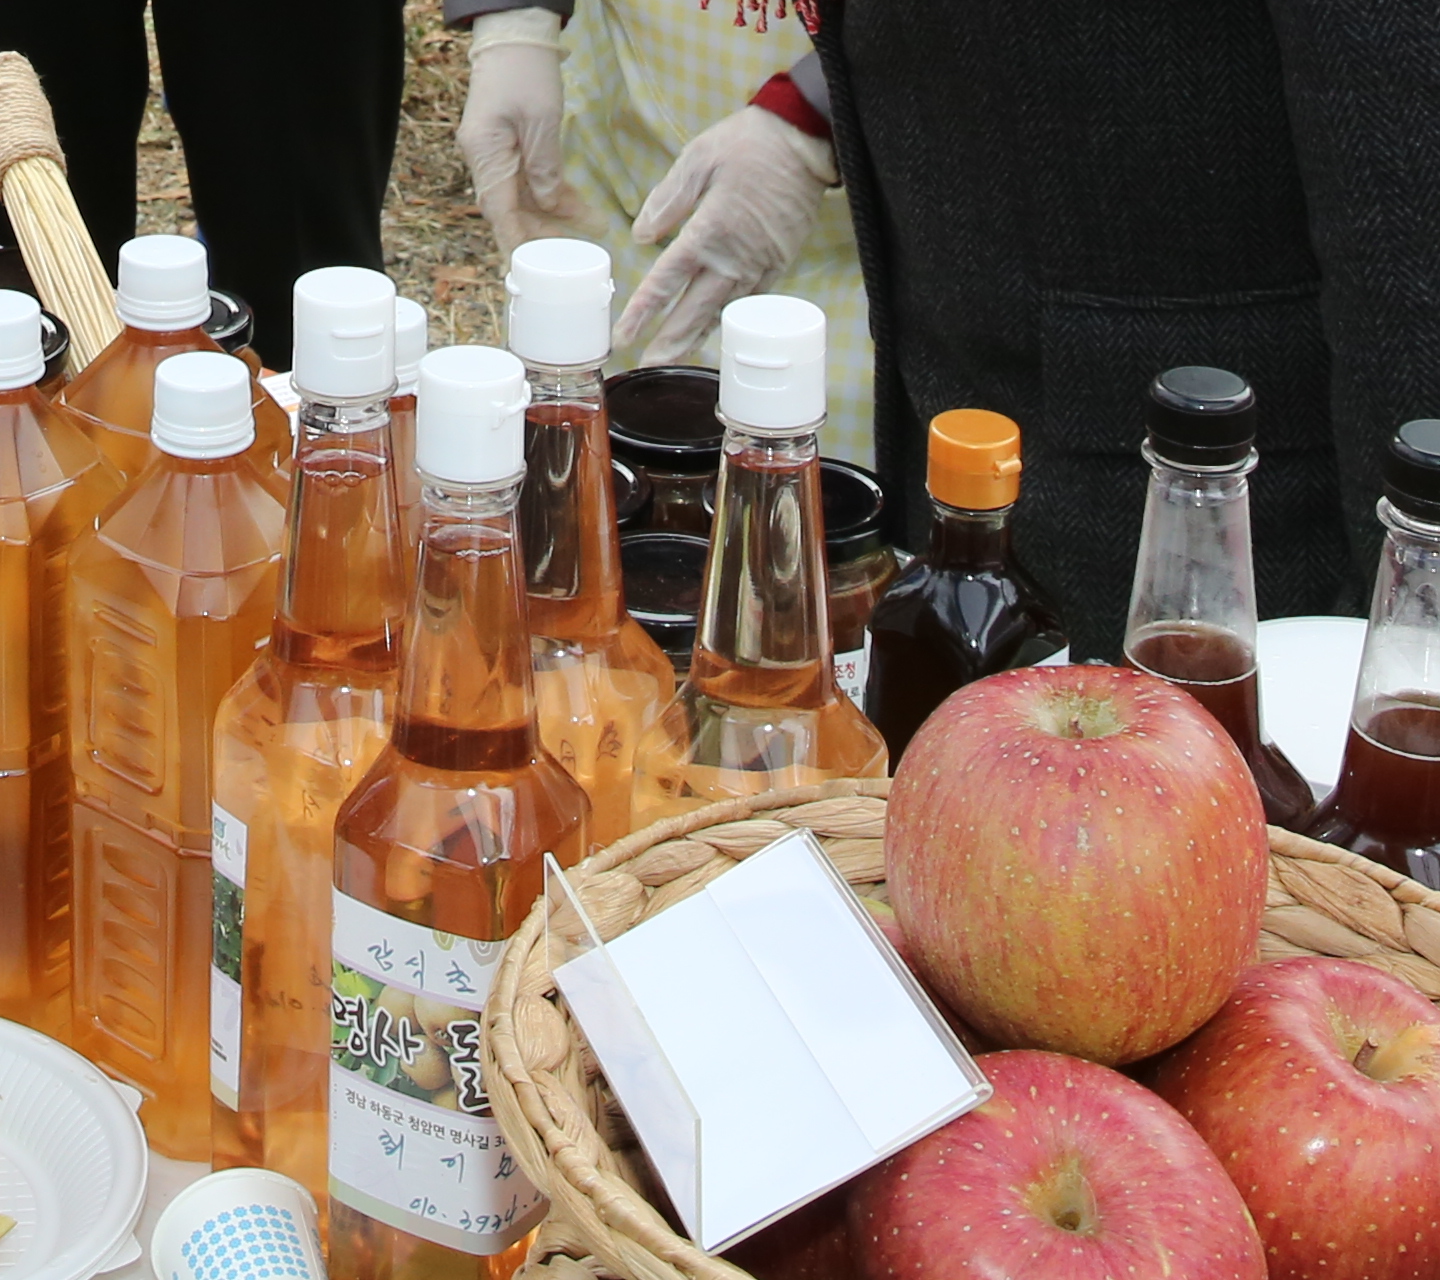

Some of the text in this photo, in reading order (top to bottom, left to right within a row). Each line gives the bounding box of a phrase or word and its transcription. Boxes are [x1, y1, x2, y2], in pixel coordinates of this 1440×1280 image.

[345, 1088, 367, 1110] 경남
[370, 1099, 405, 1127] 하동군
[407, 1115, 446, 1141] 청암면
[449, 1127, 490, 1151] 명사길
